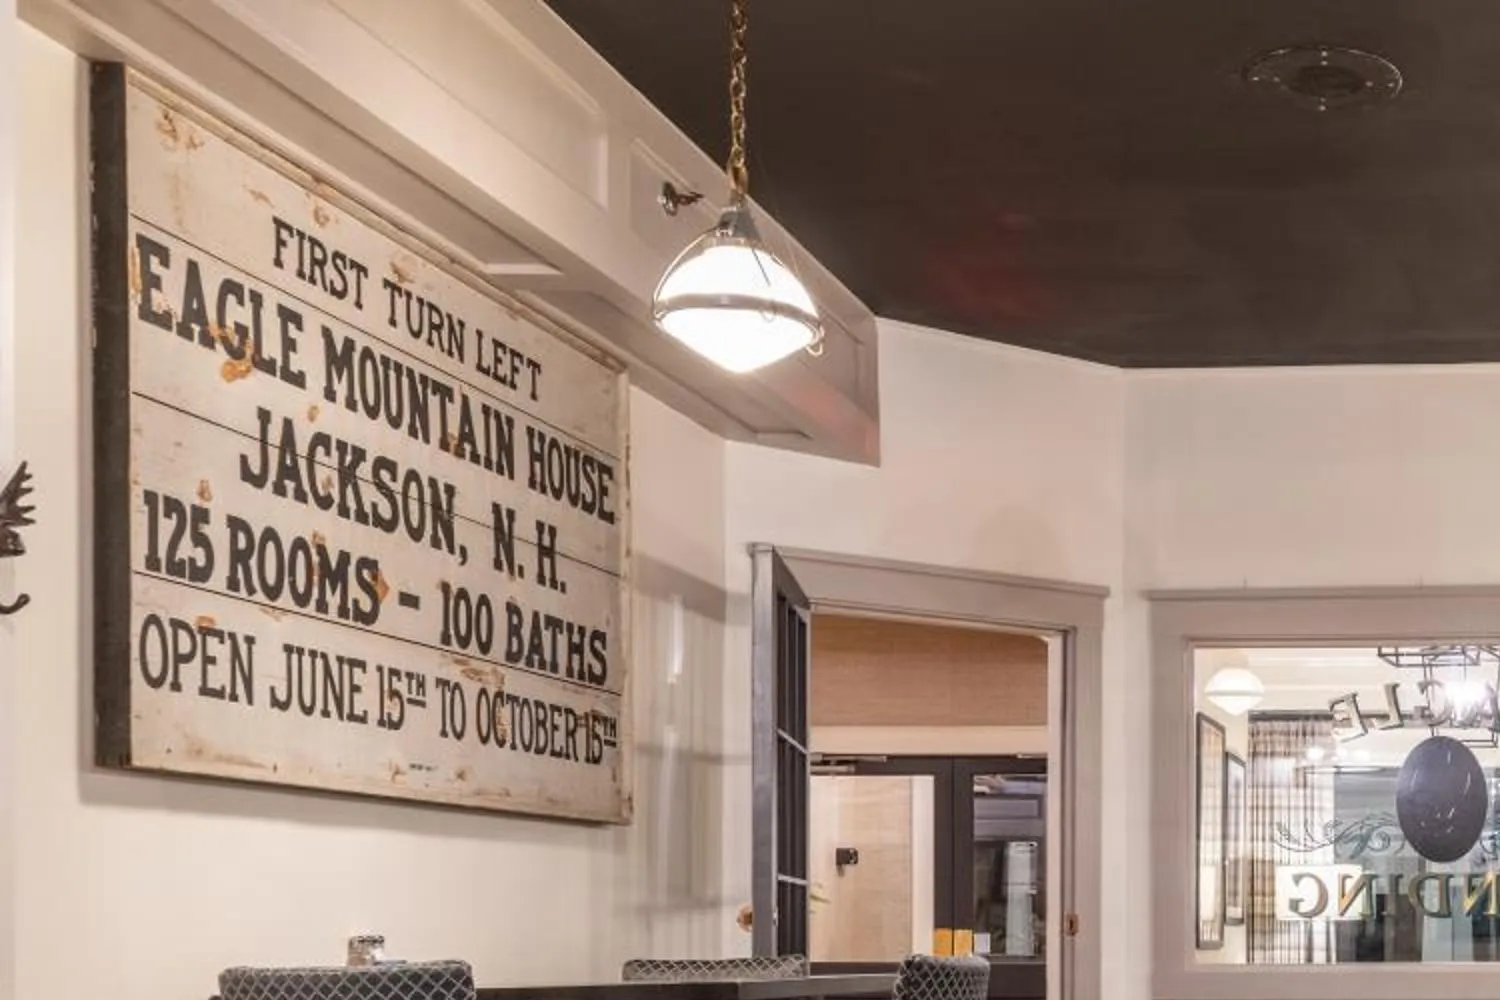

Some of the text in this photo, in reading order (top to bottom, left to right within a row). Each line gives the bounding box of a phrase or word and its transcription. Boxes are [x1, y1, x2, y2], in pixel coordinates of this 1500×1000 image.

[135, 231, 615, 525] EAGLE MOUNTAIN HOUSE
[272, 215, 542, 401] FIRST TURN LEFT
[239, 406, 468, 566] JACKSON,
[143, 489, 214, 582] 125
[226, 514, 380, 626] ROOMS
[439, 580, 494, 656] 100
[505, 600, 608, 686] BATHS
[139, 613, 256, 706] OPEN
[269, 643, 369, 725] JUNE
[435, 676, 467, 741] TO
[475, 687, 579, 762] OCTOBER
